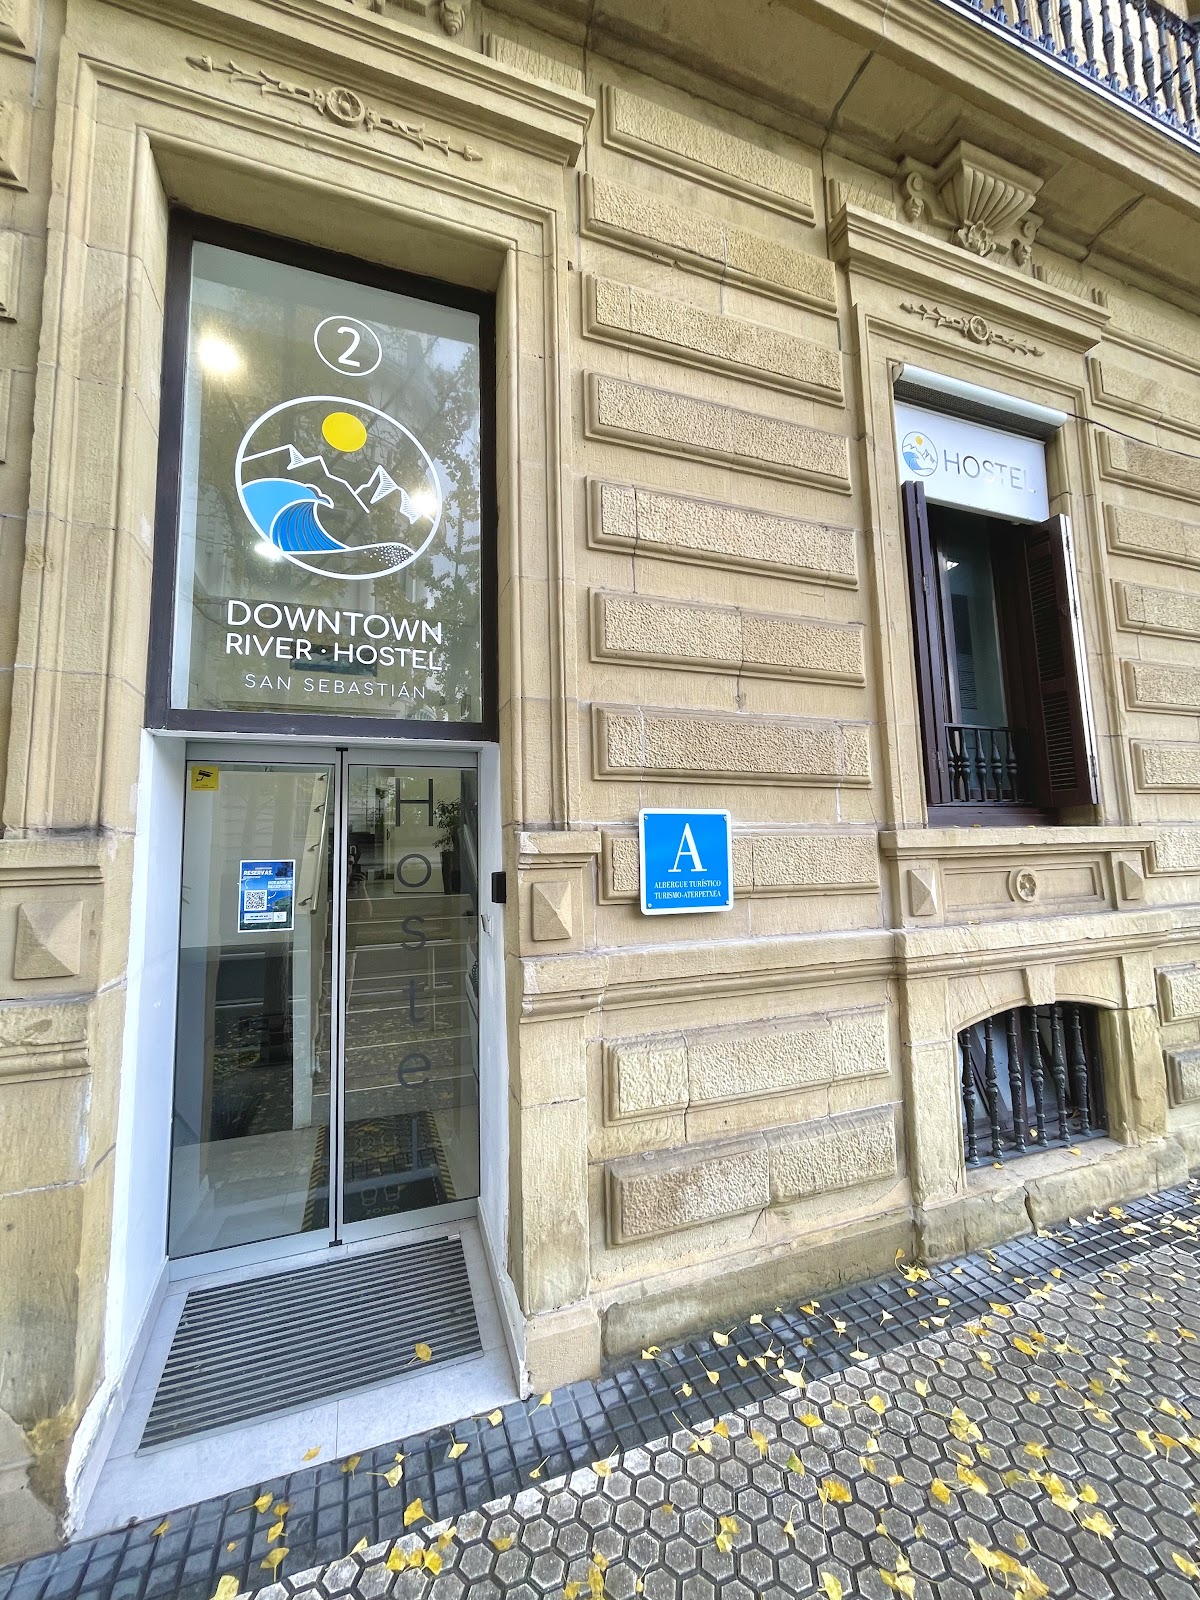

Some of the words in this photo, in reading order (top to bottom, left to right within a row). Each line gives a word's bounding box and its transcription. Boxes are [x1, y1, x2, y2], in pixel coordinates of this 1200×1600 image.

[336, 325, 361, 367] 2
[943, 449, 1036, 494] HOSTEL
[227, 600, 441, 645] DOWNTOWN
[226, 632, 312, 660] RIVER
[334, 642, 442, 671] HOSTEL
[245, 673, 291, 690] SAN
[303, 677, 425, 699] SEBASTIÁN
[667, 822, 708, 873] A
[654, 890, 721, 899] TURISMO-ATERPETXEA
[689, 879, 721, 887] TURÍSTICO
